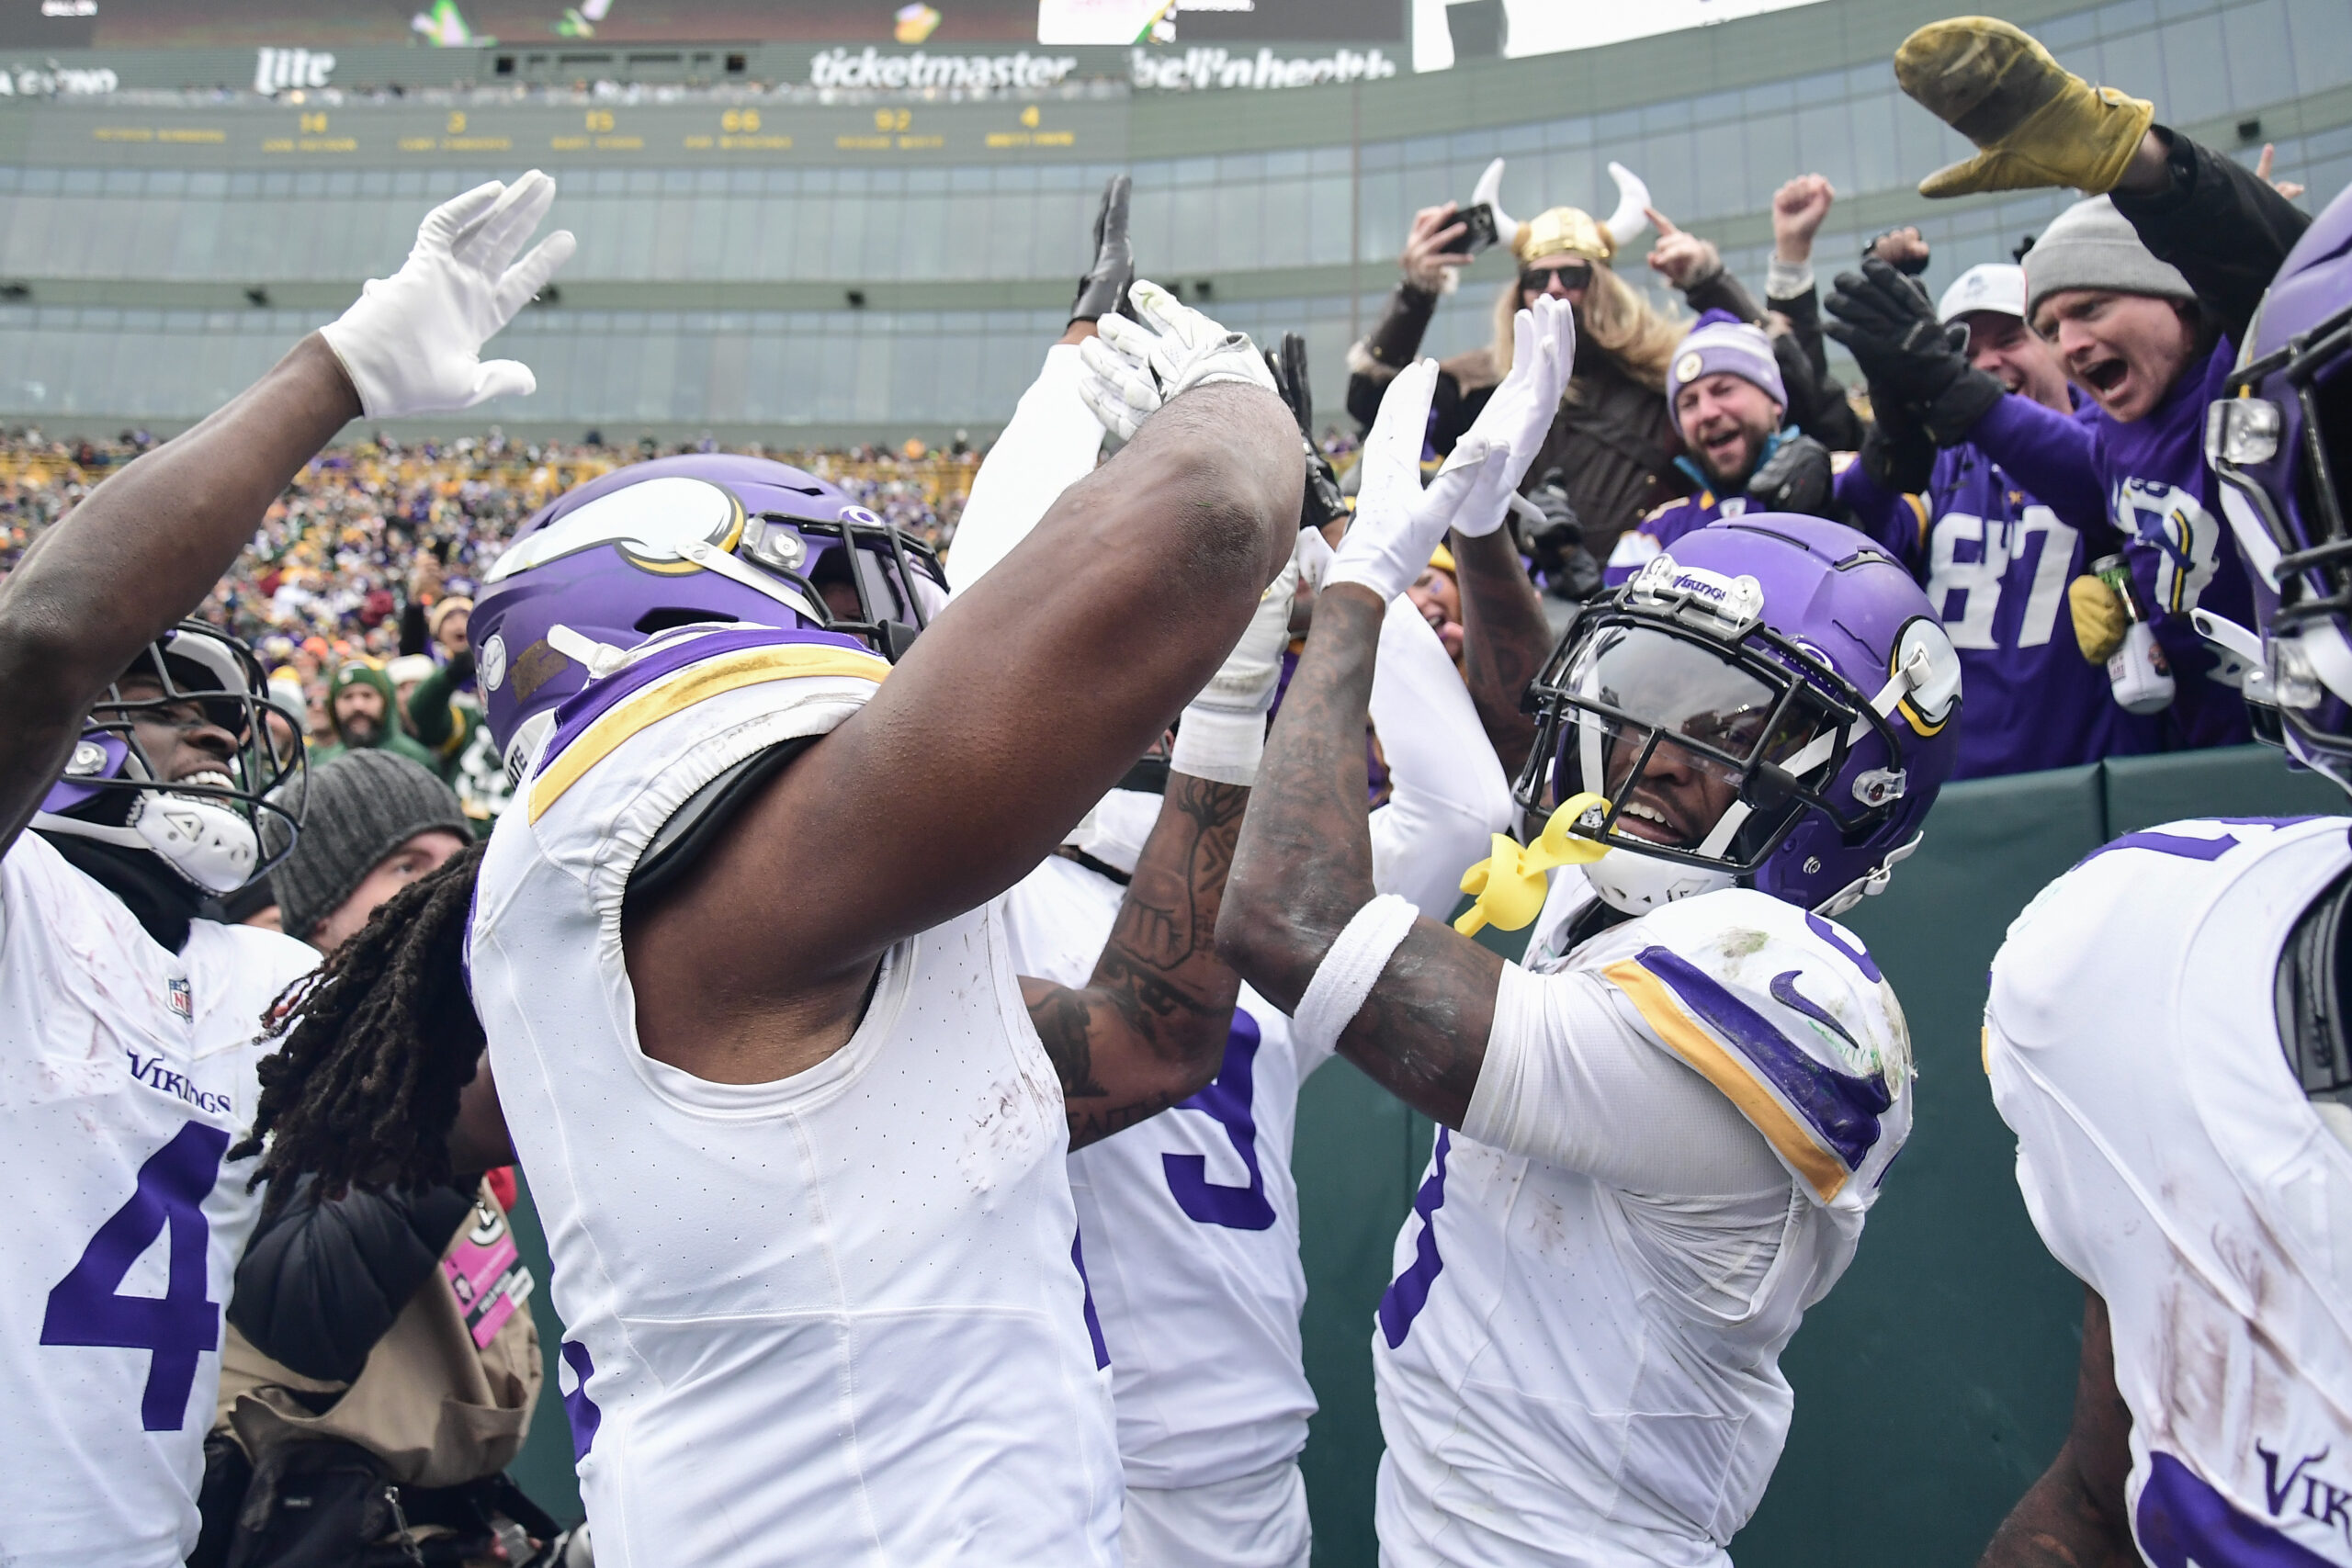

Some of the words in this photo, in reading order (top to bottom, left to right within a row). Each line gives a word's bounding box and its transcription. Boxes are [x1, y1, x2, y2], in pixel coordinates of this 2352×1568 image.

[810, 47, 1077, 88] ticketmaster
[1927, 505, 2078, 649] 87
[40, 1120, 231, 1432] 4
